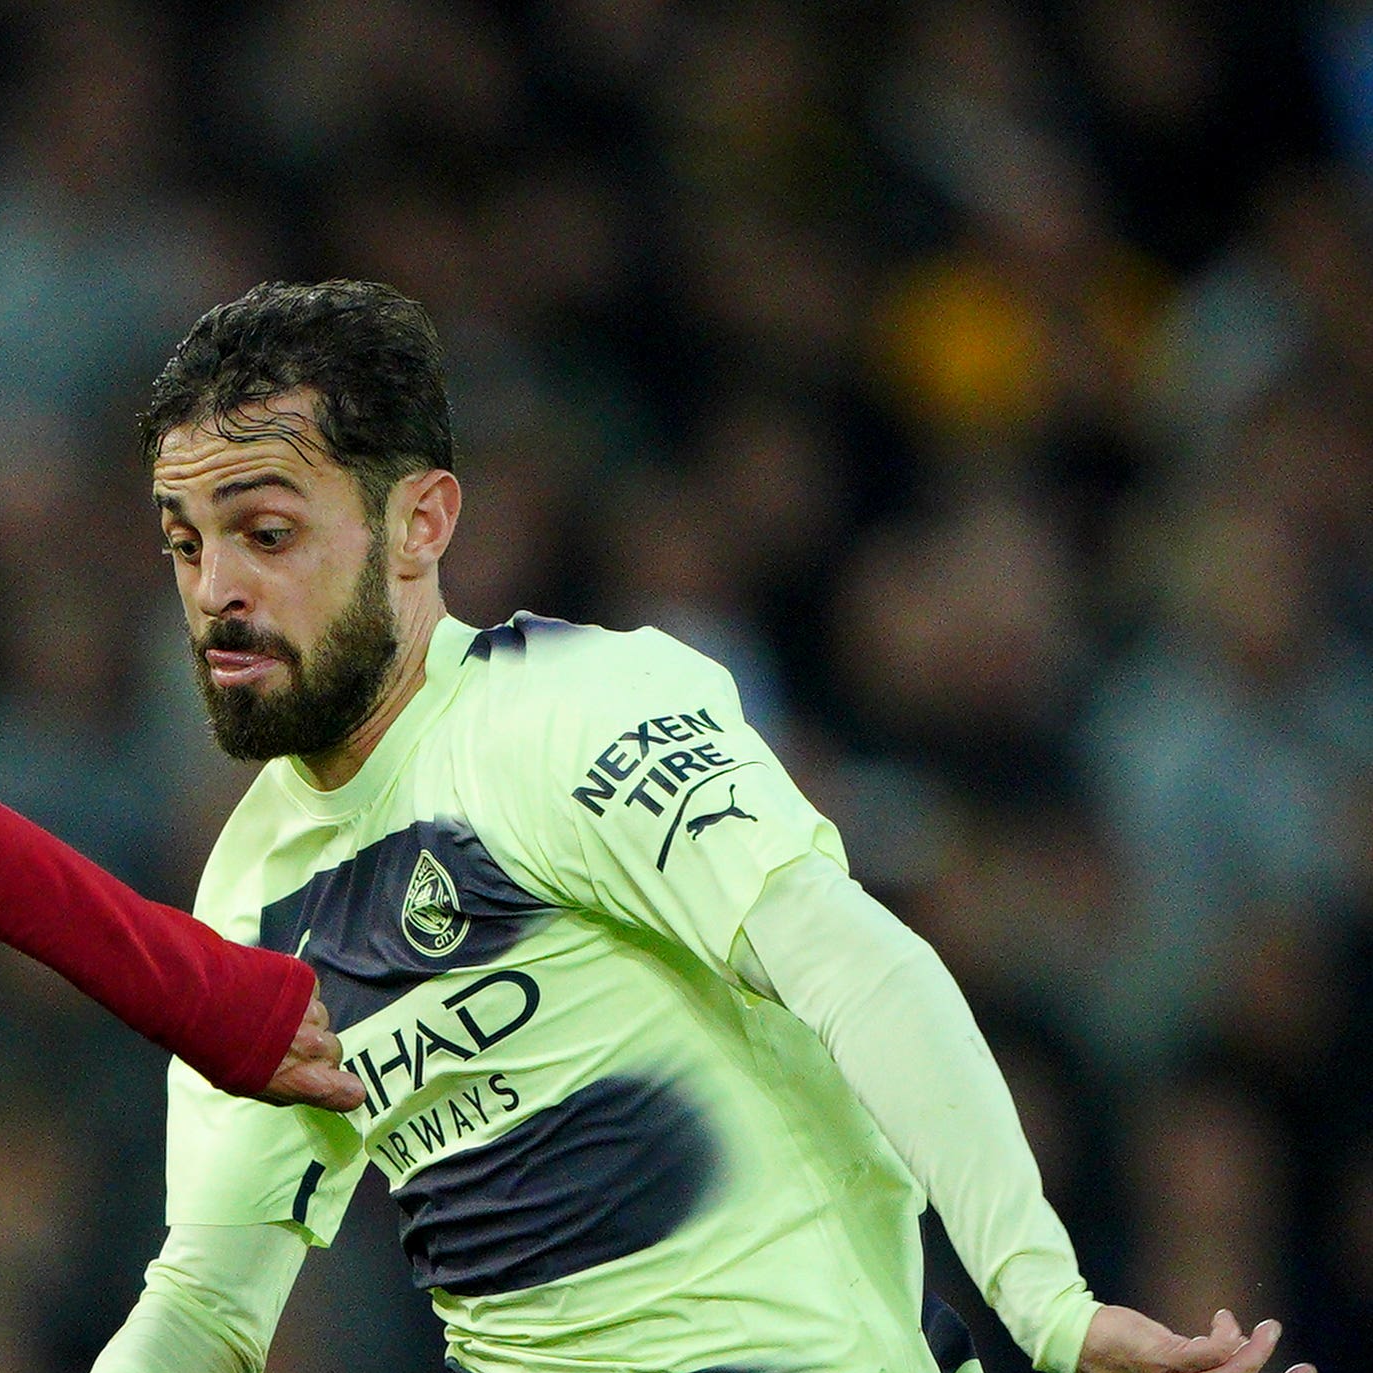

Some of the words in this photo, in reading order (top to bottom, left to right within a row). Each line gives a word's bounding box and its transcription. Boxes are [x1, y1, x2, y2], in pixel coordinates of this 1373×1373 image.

[571, 707, 725, 818] NEXEN
[623, 742, 737, 818] TIRE
[434, 927, 455, 949] CITY
[342, 969, 541, 1120] IHAD
[375, 1072, 521, 1176] IRWAYS
